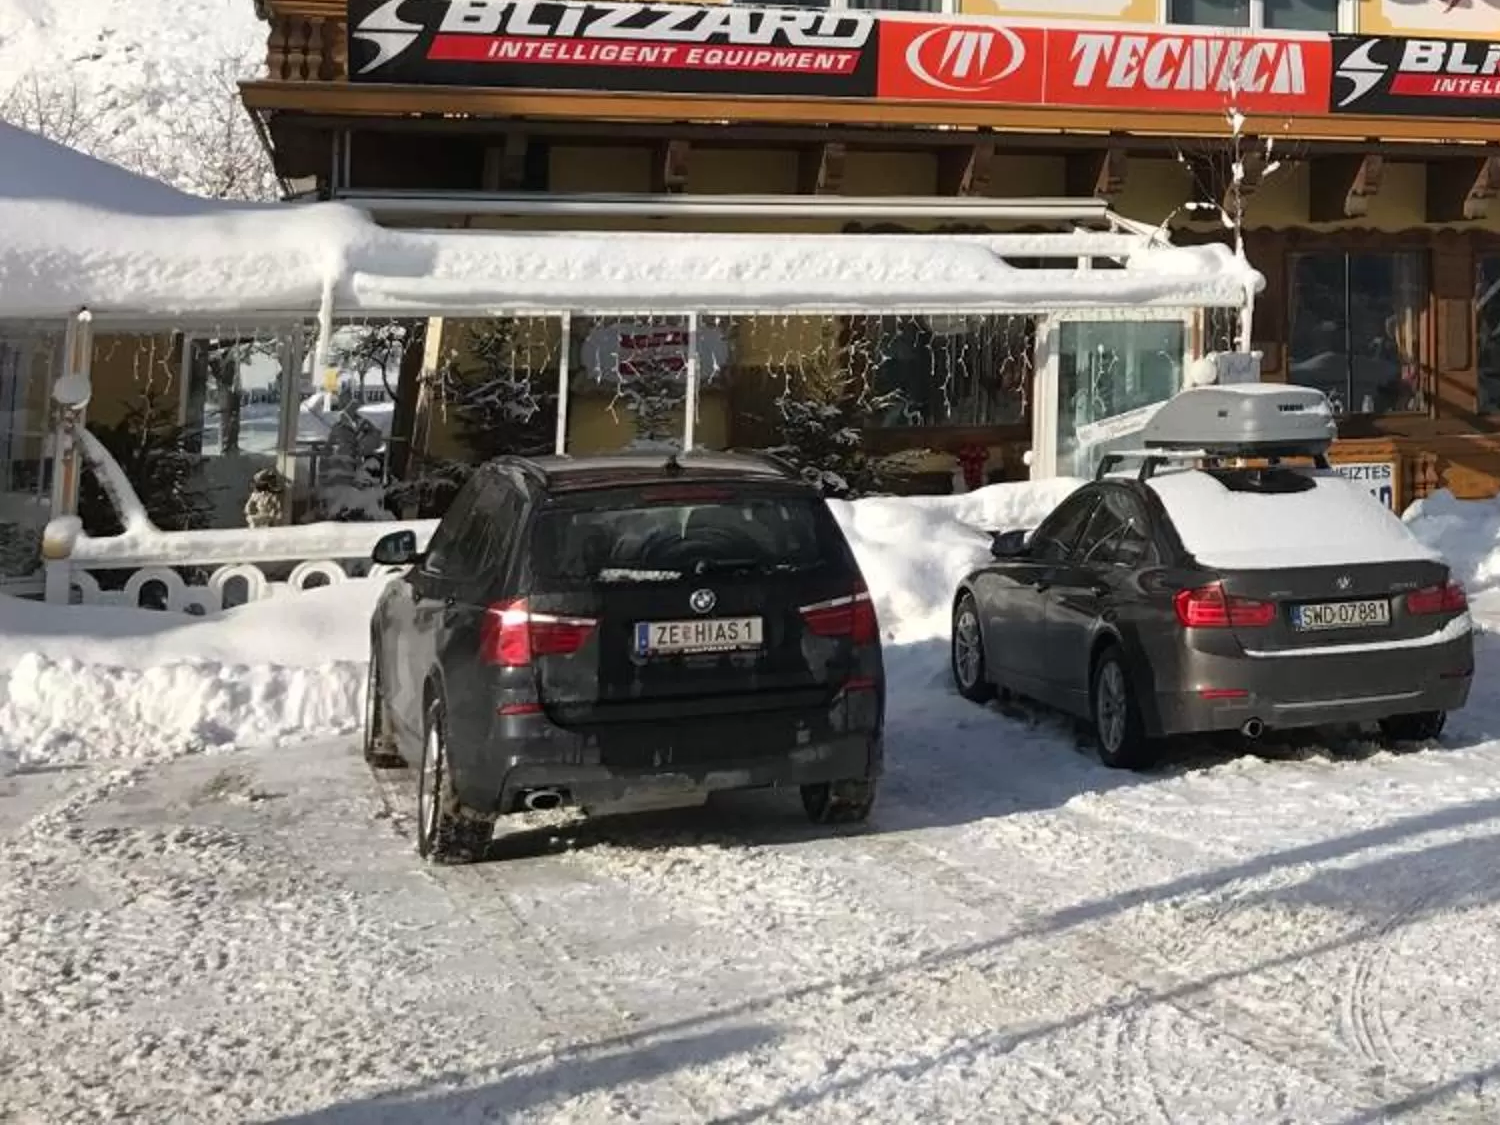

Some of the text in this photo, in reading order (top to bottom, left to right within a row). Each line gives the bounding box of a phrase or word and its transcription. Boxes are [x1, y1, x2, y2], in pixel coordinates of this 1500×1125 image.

[487, 40, 854, 71] INTELLIGENT EQUIPMENT
[1069, 32, 1306, 94] TECNICA
[656, 625, 680, 646] ZE
